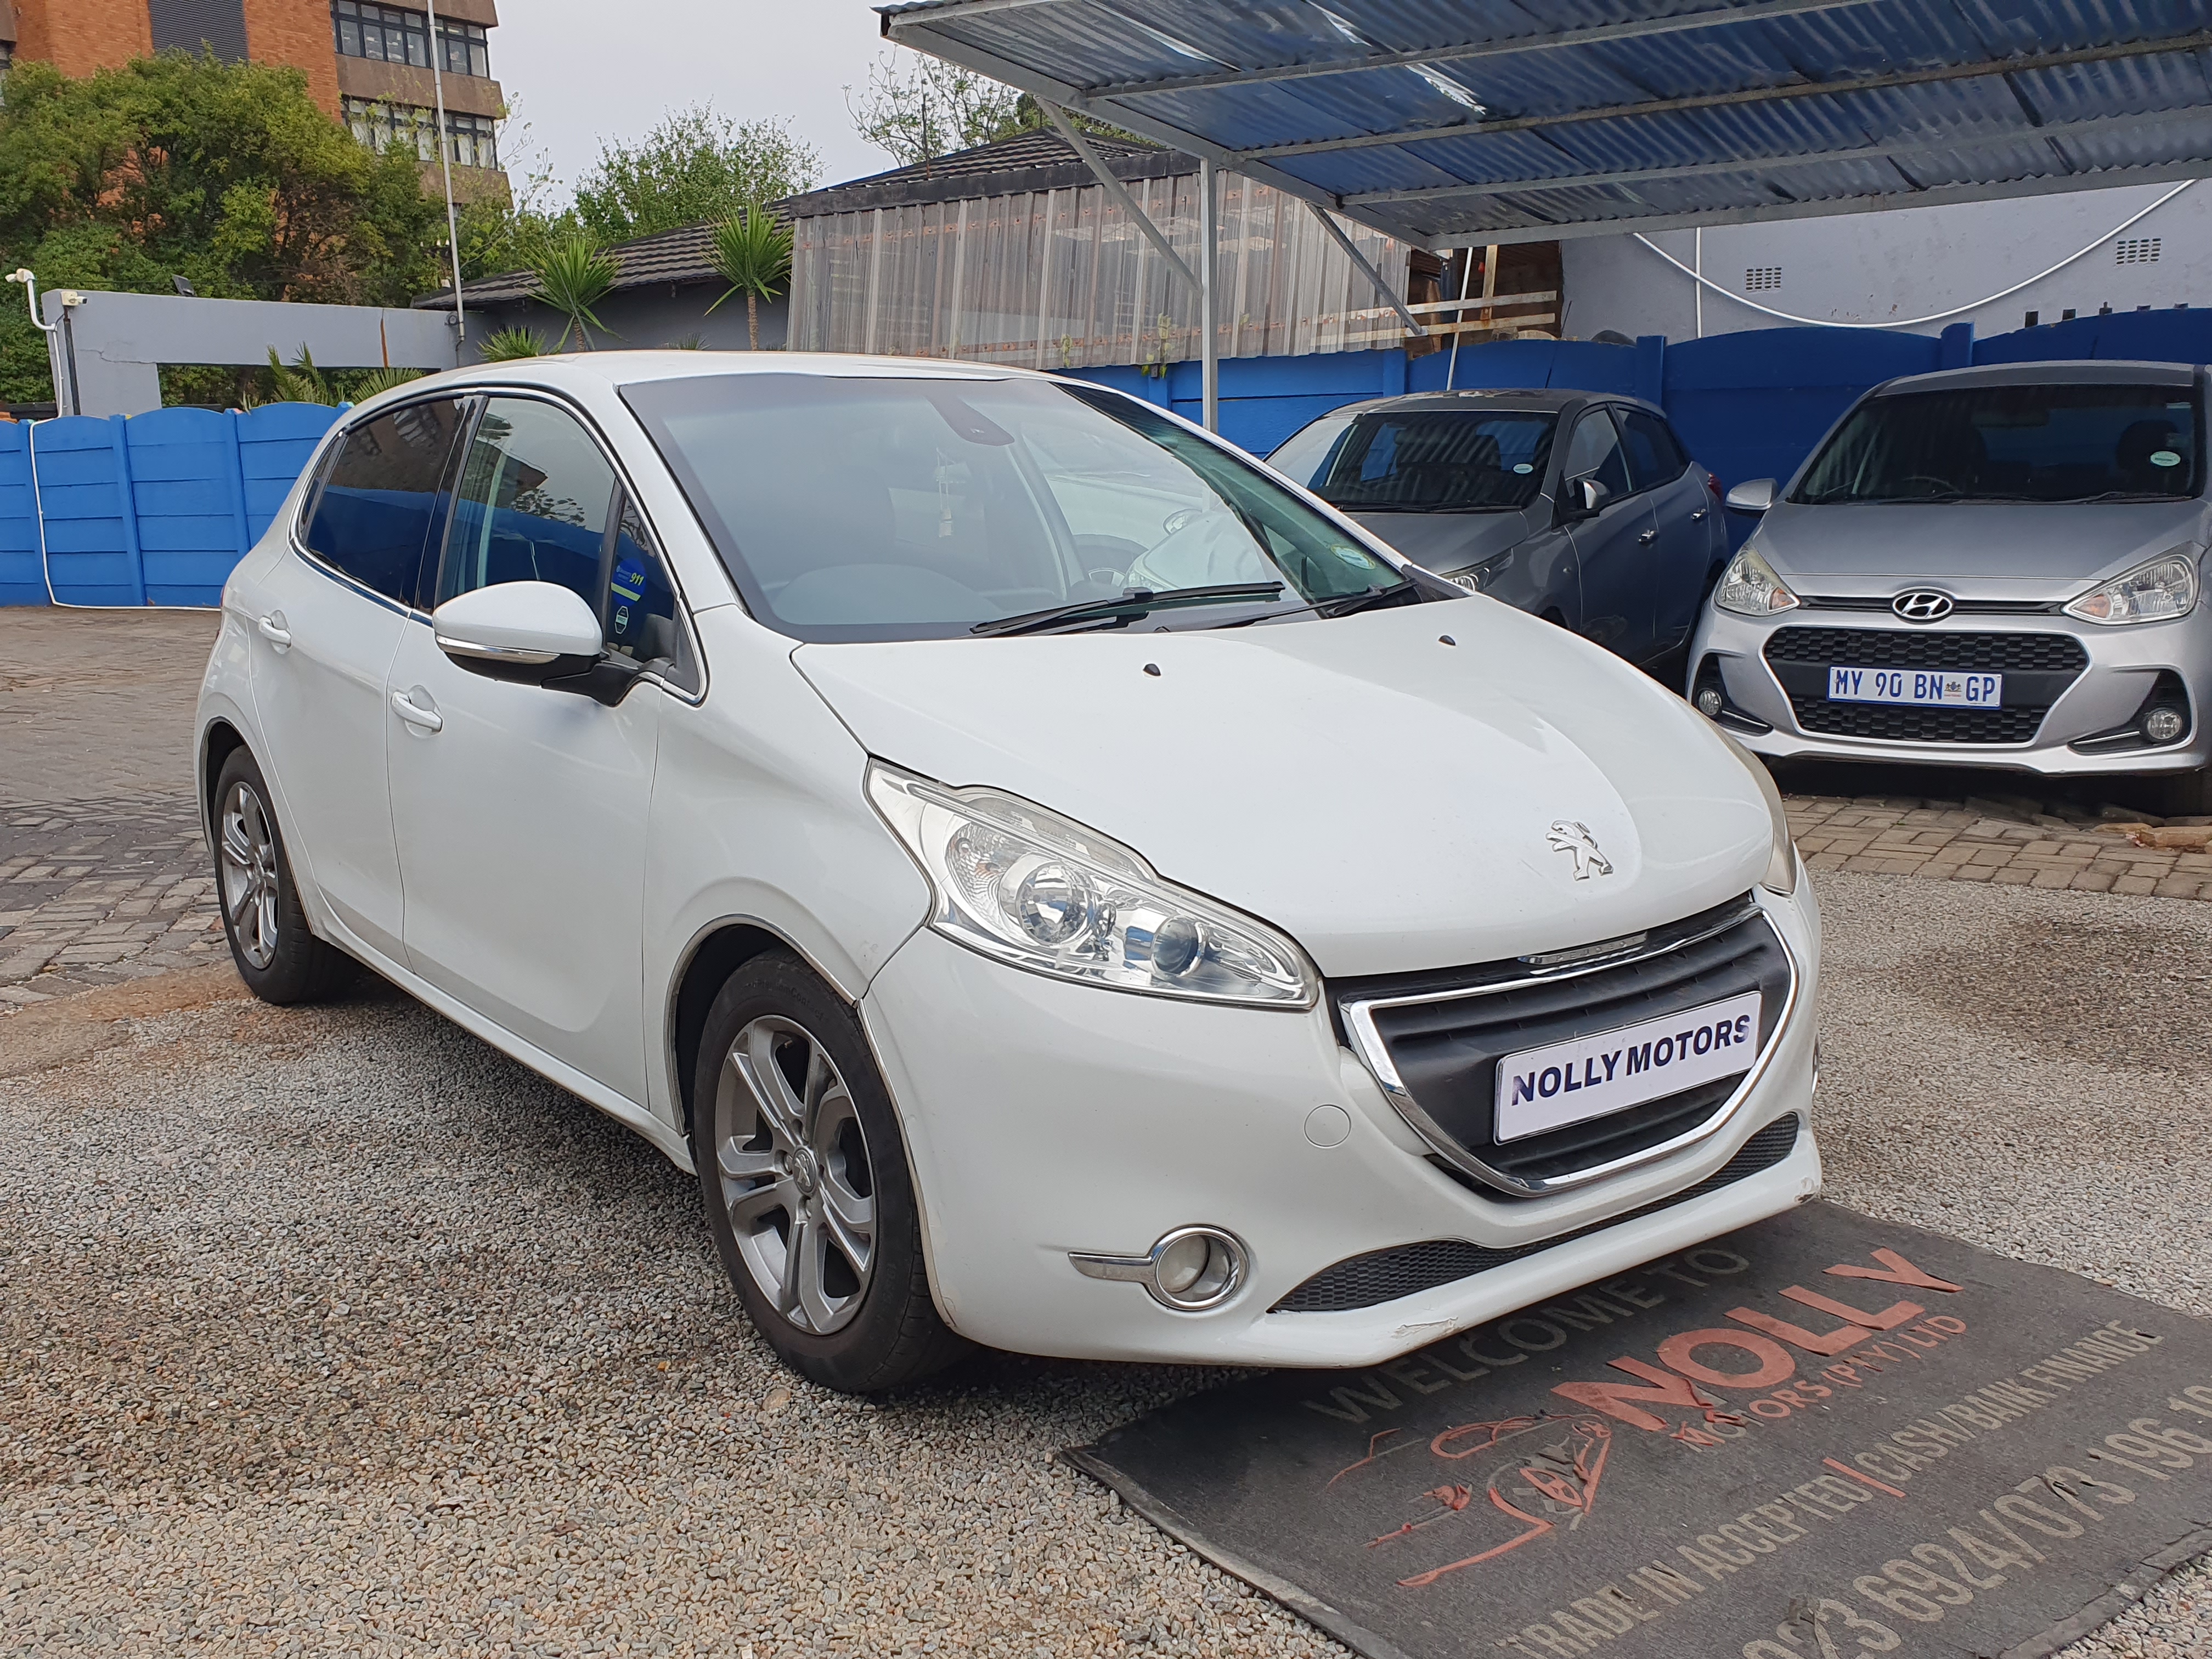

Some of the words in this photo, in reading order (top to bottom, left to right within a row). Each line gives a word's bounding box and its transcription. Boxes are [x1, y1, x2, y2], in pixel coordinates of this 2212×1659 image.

[629, 572, 645, 586] 911
[1835, 670, 1863, 695] MY
[1875, 672, 1903, 698] 90
[1914, 674, 1944, 700] BN
[1966, 676, 1996, 702] GP
[1510, 1049, 1623, 1106] NOLLY
[1626, 1014, 1751, 1076] MOTORS
[1301, 1278, 1666, 1424] WELCOME
[1644, 1248, 1750, 1289] TO
[1550, 1247, 1965, 1431] NOLLY
[1820, 1341, 1922, 1388] (PTY)
[1897, 1315, 1967, 1348] LTD
[1494, 1584, 1661, 1659] TRADE
[1626, 1559, 1706, 1606] IN
[1676, 1474, 1874, 1581] ACCEPTED
[2019, 1319, 2164, 1391] FINANCE
[2086, 1417, 2212, 1481] 196
